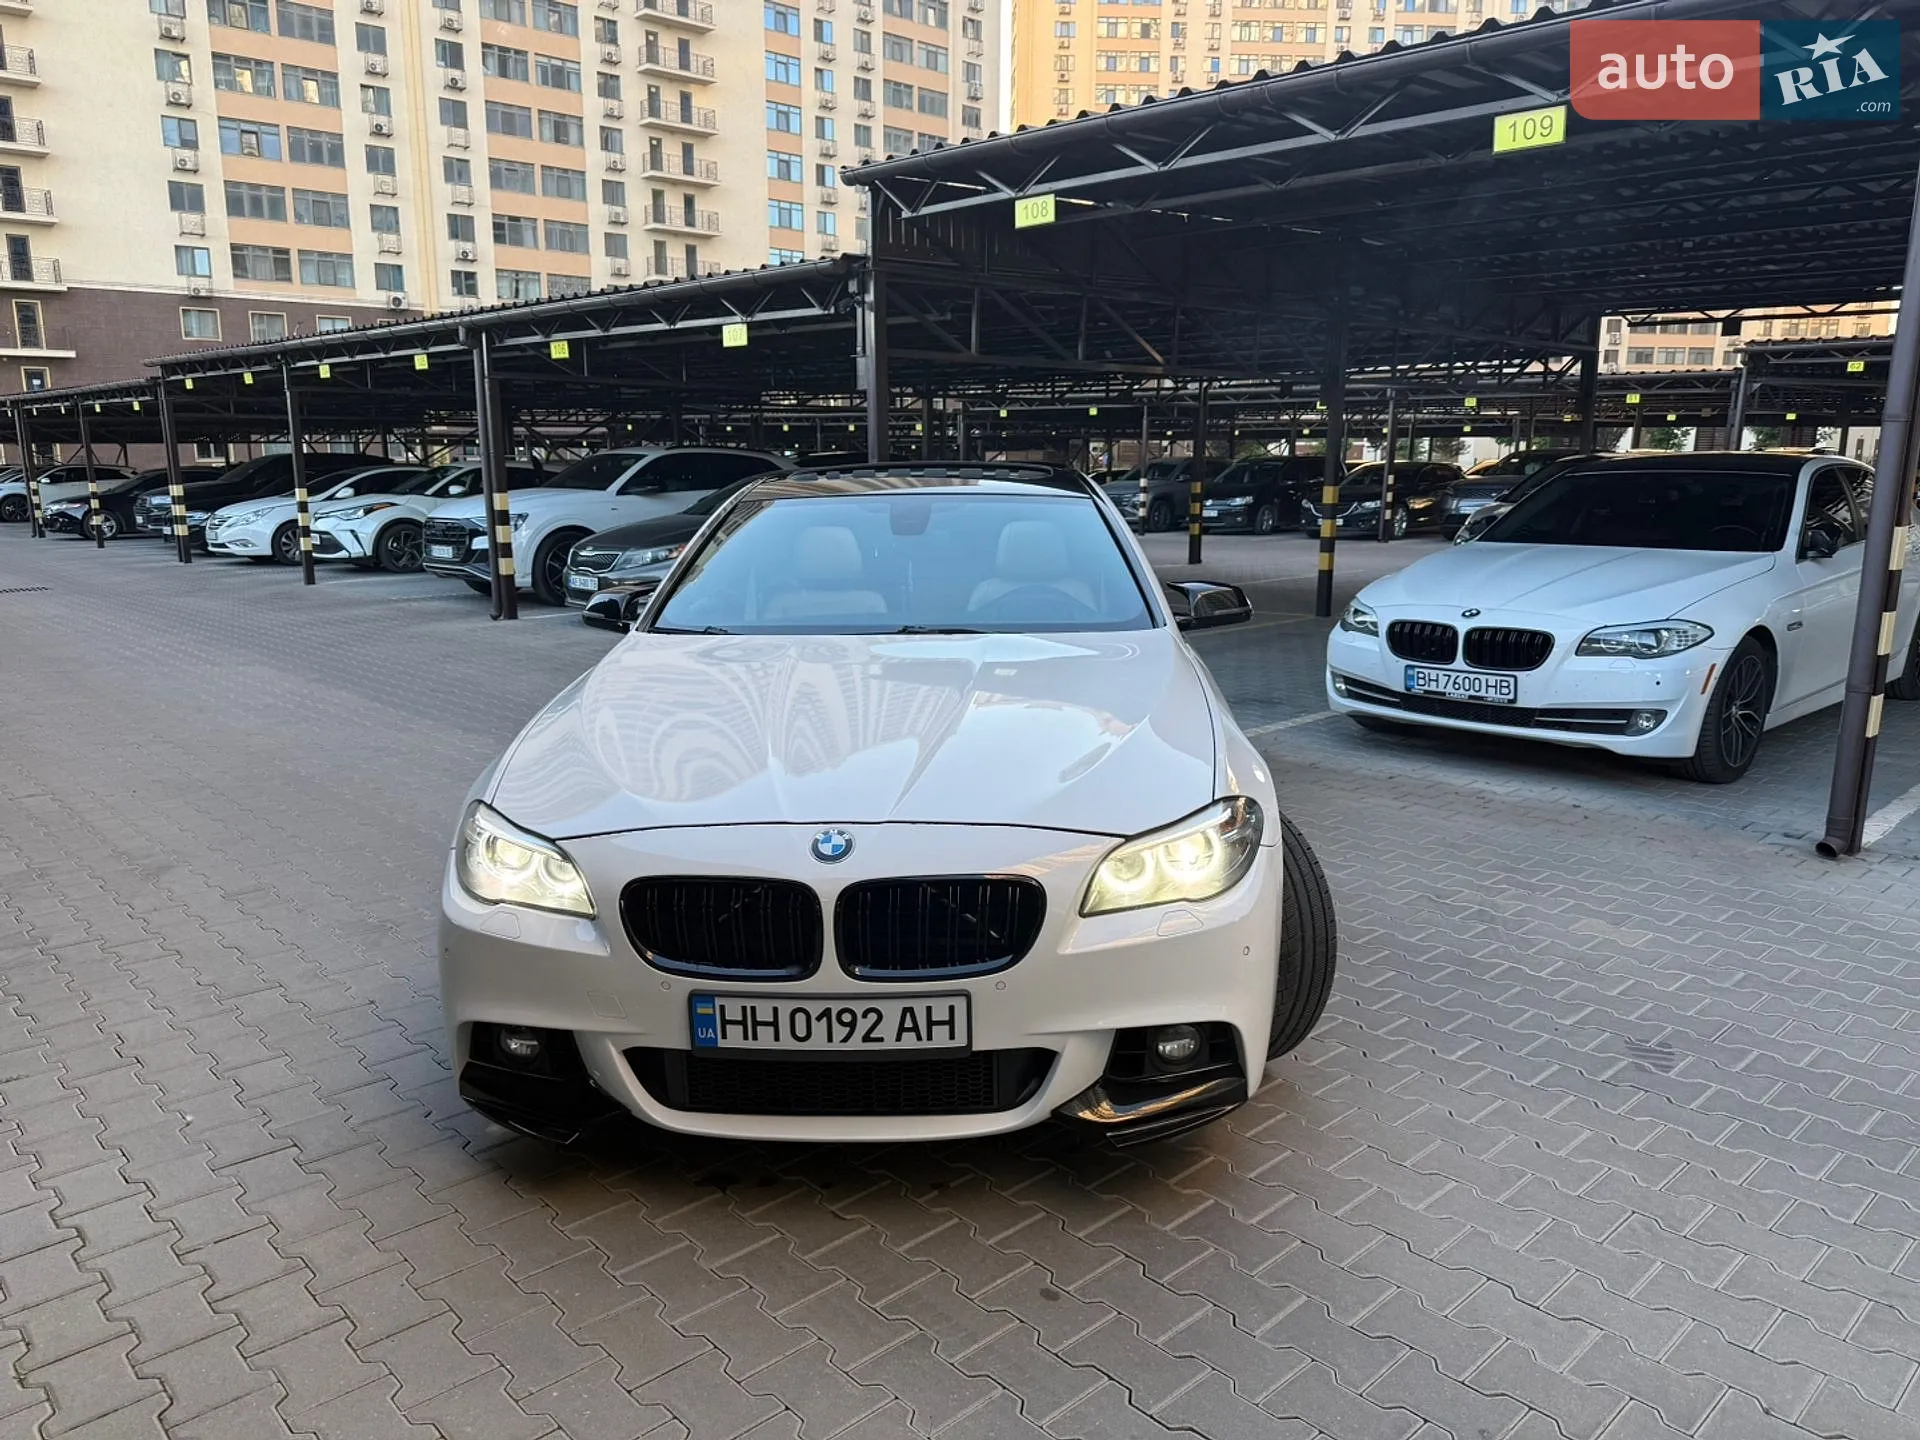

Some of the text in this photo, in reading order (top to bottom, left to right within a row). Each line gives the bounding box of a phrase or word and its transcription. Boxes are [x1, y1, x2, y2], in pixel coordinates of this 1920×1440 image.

[1508, 115, 1553, 142] 109
[1023, 200, 1049, 220] 108
[727, 327, 745, 342] 107
[1416, 670, 1440, 690] BH
[1442, 673, 1482, 694] 7600
[1486, 678, 1512, 697] HB
[698, 1027, 716, 1040] UA
[719, 1004, 956, 1043] HH 0192 AH
